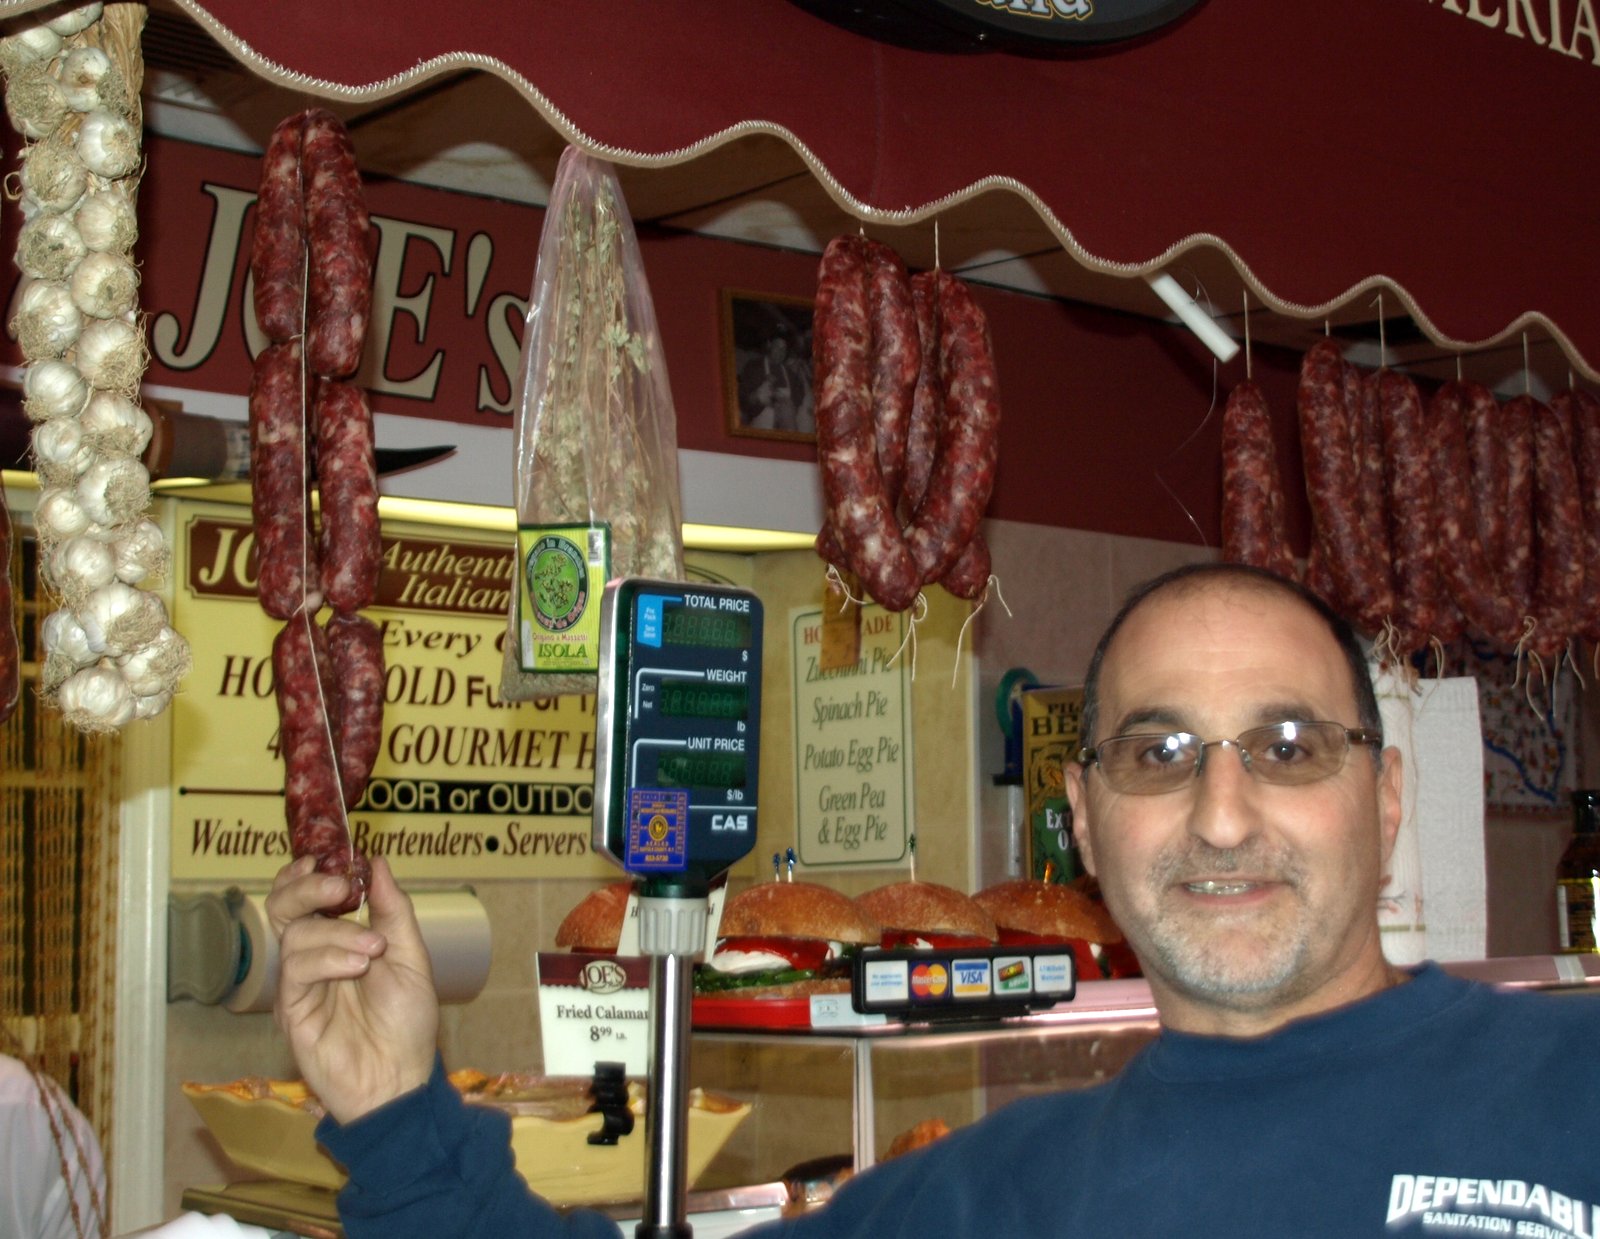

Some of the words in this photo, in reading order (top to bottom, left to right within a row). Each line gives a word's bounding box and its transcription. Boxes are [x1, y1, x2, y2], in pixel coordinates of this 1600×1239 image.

[152, 183, 530, 415] JE's
[383, 540, 515, 580] Authenti
[397, 574, 511, 610] Italian
[684, 594, 717, 609] TOTAL
[719, 598, 750, 613] PRICE
[380, 619, 482, 659] Every
[538, 643, 588, 658] ISOLA
[742, 650, 749, 662] $
[385, 663, 456, 706] OLD
[706, 668, 748, 683] WEIGHT
[812, 692, 862, 731] Spinach
[865, 690, 888, 718] Pie
[737, 720, 746, 732] lb
[387, 722, 569, 770] GOURMET
[687, 737, 712, 749] UNIT
[714, 738, 745, 752] PRICE
[804, 744, 845, 770] Potato
[847, 739, 874, 773] Egg
[877, 736, 899, 764] Pie
[449, 787, 481, 811] or
[488, 783, 593, 814] OUTDO
[726, 788, 744, 801] $/lb
[818, 785, 857, 812] Green
[860, 782, 886, 809] Pea
[191, 818, 290, 857] Waitres
[353, 821, 484, 857] Bartenders
[503, 822, 588, 857] Servers
[711, 814, 748, 831] CAS
[818, 817, 830, 845] &
[834, 816, 861, 851] Egg
[864, 814, 888, 842] Pie
[960, 971, 984, 984] VISA
[557, 1005, 592, 1019] Fried
[595, 1006, 649, 1020] Calamar
[1386, 1174, 1600, 1239] DEPENDABL
[1423, 1211, 1512, 1233] SANITATION
[1516, 1220, 1577, 1239] SERVI
